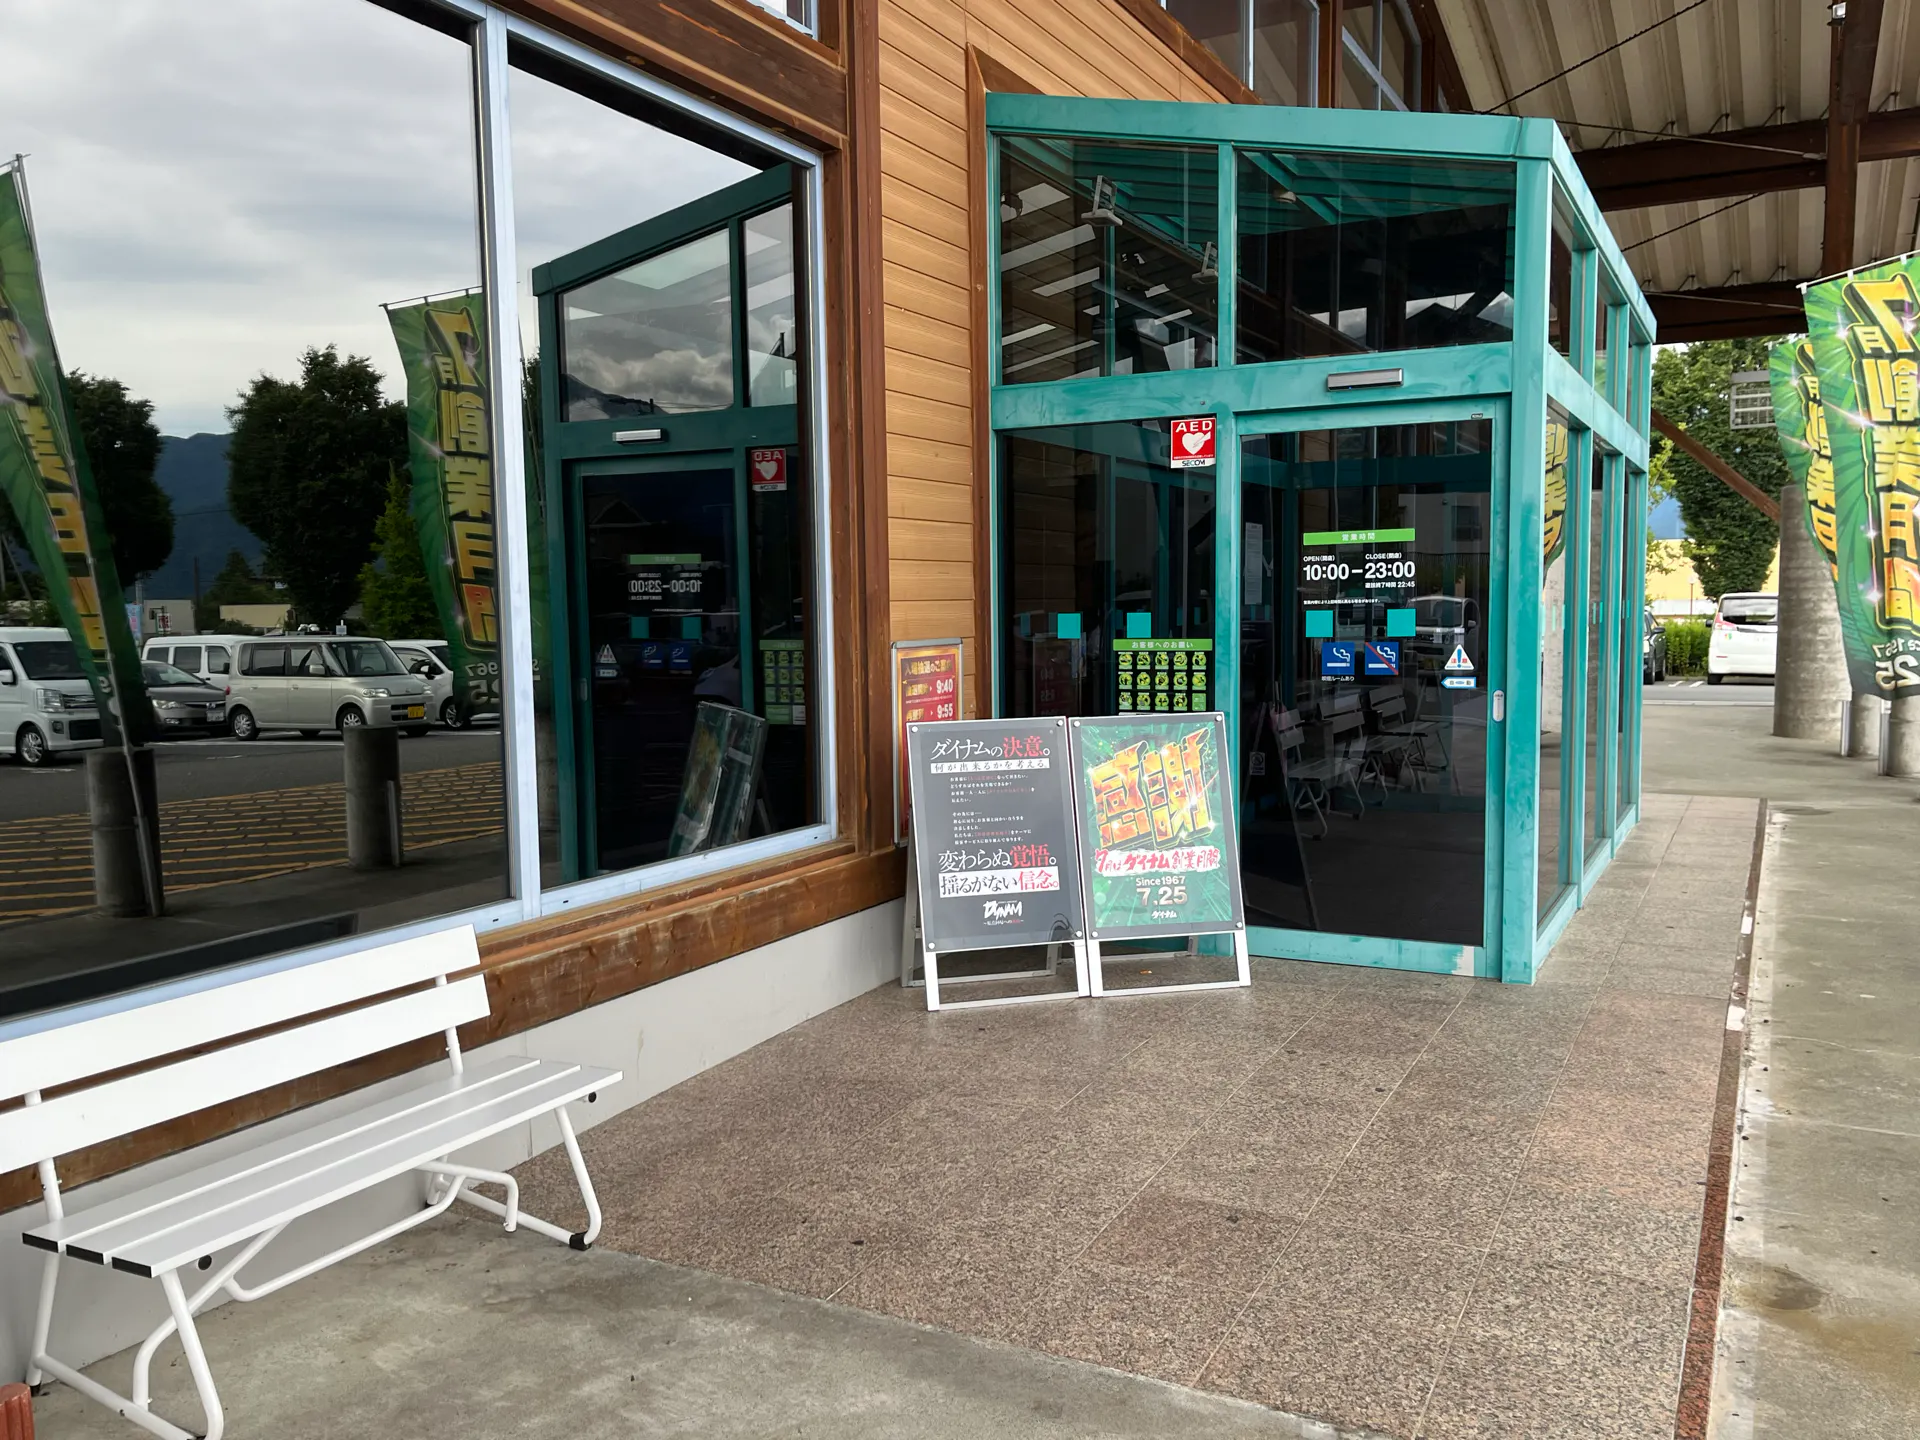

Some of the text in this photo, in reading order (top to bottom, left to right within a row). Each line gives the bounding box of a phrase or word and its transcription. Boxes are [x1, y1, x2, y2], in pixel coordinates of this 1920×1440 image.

[1175, 420, 1212, 433] AED
[1181, 459, 1206, 467] SECOM
[1341, 532, 1375, 542] 営業時間
[1397, 580, 1416, 588] 22:45
[1131, 641, 1194, 649] お客様へのお願い
[936, 678, 954, 694] 9:40
[936, 703, 954, 719] 9:55
[930, 735, 1051, 760] ダイナムの決意。
[1088, 727, 1215, 848] 感謝
[938, 843, 1057, 873] 変わらぬ覚悟。
[940, 869, 1059, 896] 揺るがない信念。
[1135, 875, 1186, 886] Since 1967
[1136, 885, 1188, 906] 7.25
